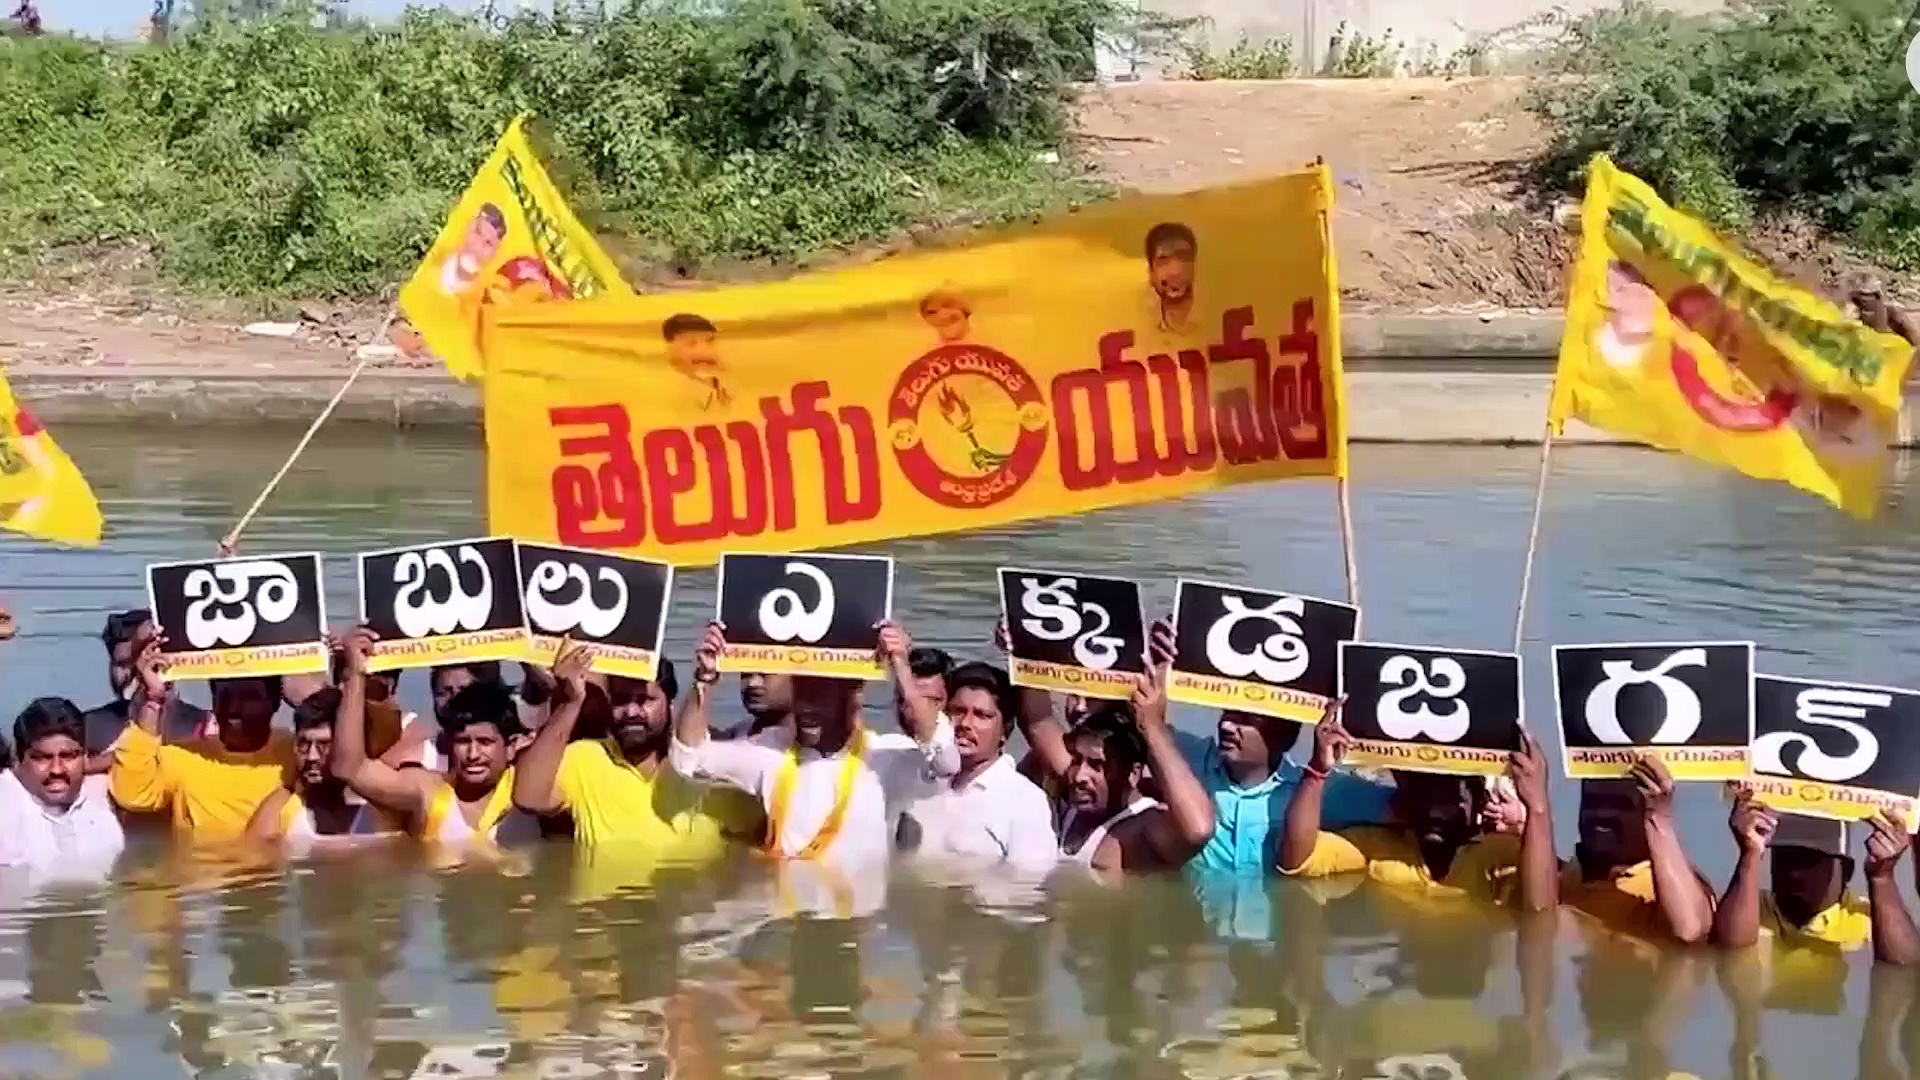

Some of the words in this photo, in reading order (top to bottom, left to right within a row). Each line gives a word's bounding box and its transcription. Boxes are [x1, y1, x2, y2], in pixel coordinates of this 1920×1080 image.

[549, 380, 882, 548] తెలుగు
[1051, 298, 1330, 491] యువత
[896, 356, 951, 408] తెలుగు
[953, 352, 1027, 392] యువత
[183, 558, 299, 648] జా
[393, 544, 494, 638] బు
[526, 560, 629, 638] లు
[758, 562, 835, 643] ఎ
[1021, 577, 1124, 671] క్క
[1083, 670, 1131, 686] యువ
[1205, 594, 1311, 682] డ
[1270, 690, 1325, 710] యువ
[1376, 654, 1470, 741] జ
[1585, 648, 1707, 744] గ
[1754, 687, 1894, 782] న్
